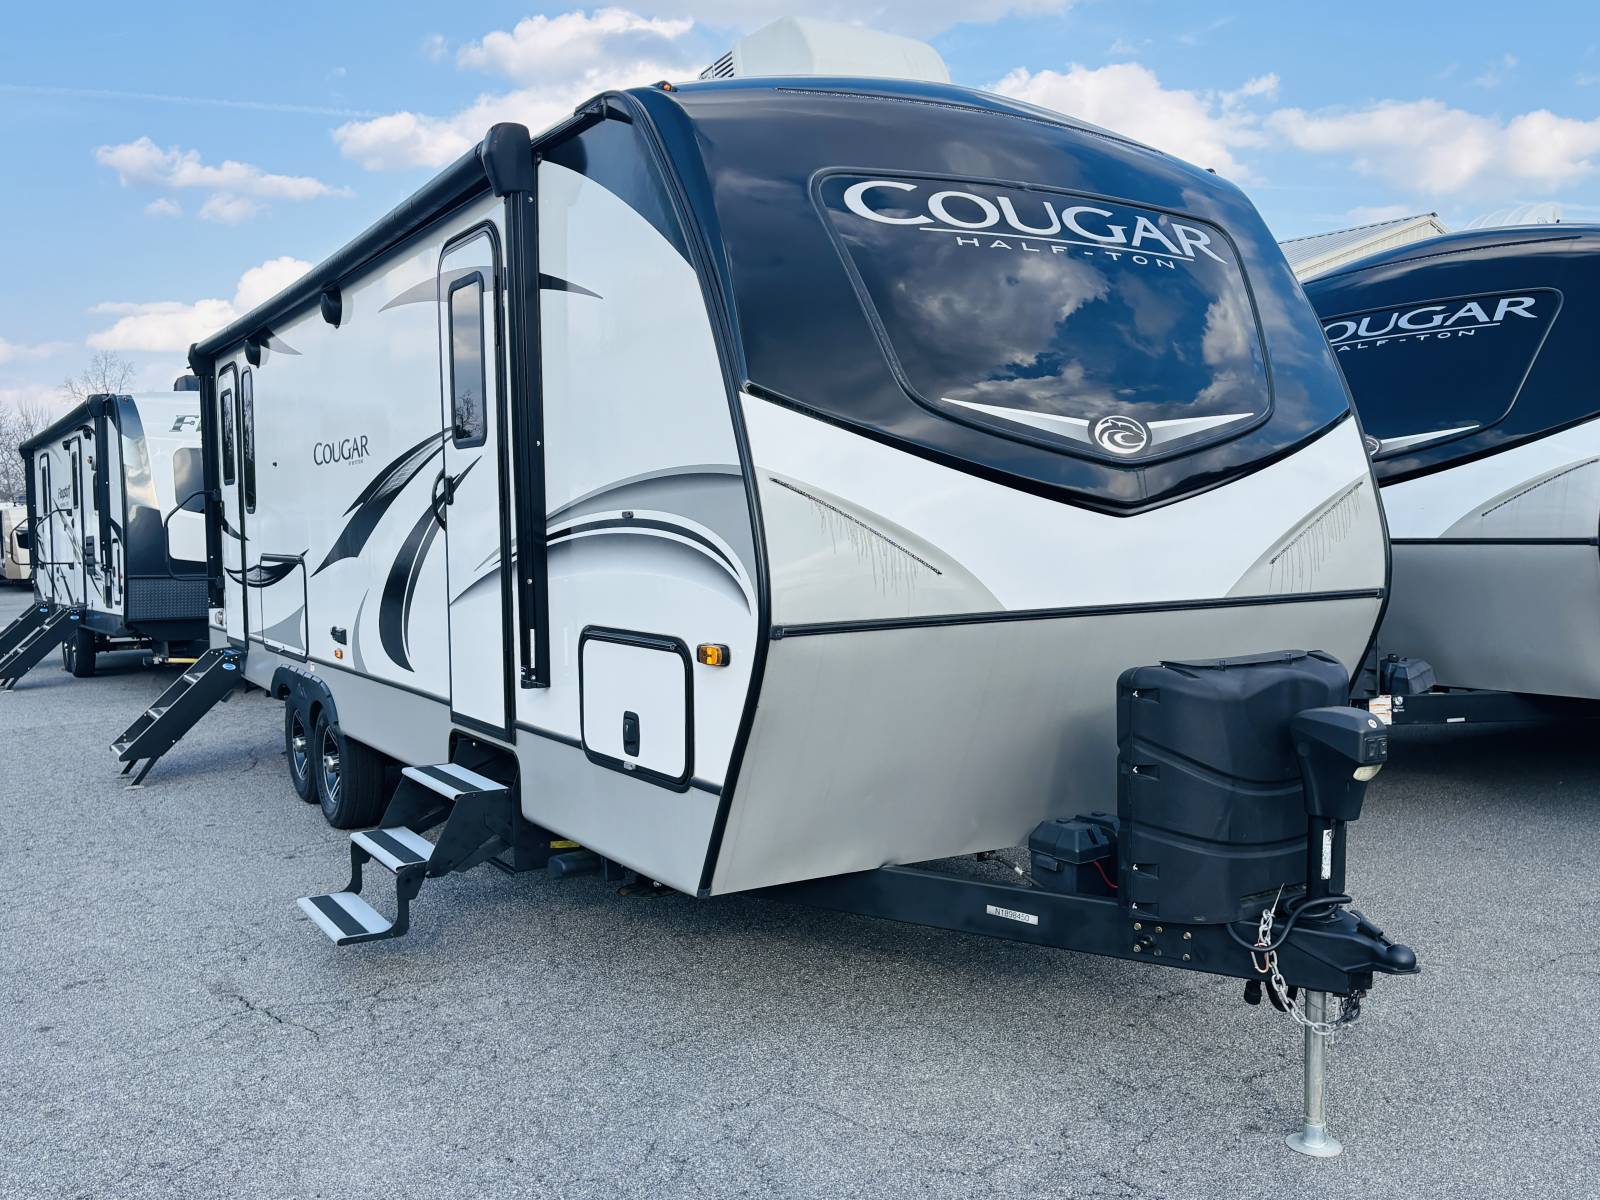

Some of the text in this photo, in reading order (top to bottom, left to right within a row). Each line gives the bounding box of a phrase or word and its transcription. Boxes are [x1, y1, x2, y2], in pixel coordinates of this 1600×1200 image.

[843, 180, 1227, 264] COUGAR
[955, 236, 1176, 270] HALF-TON
[1323, 297, 1538, 343] OUGAR
[1337, 329, 1476, 352] ALF-TON
[313, 435, 370, 465] COUGAR
